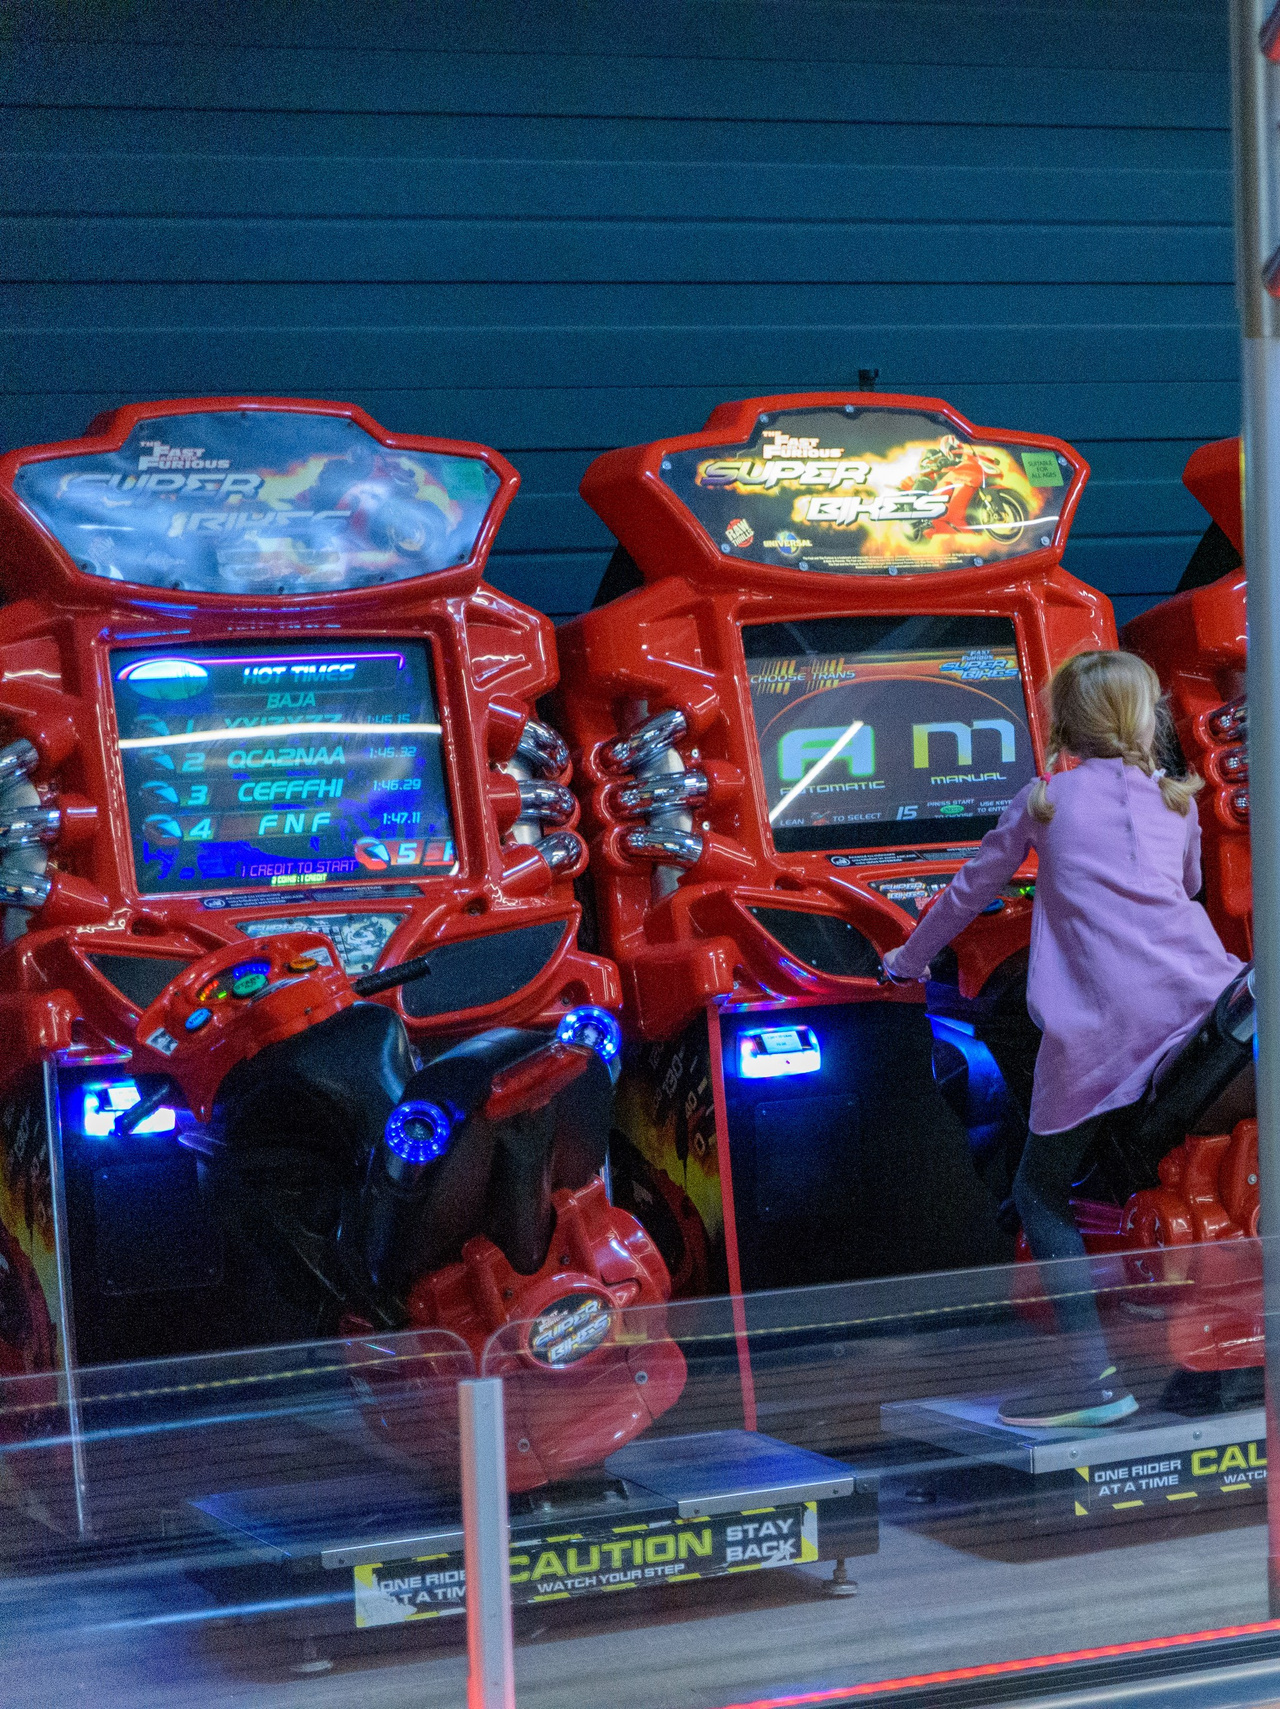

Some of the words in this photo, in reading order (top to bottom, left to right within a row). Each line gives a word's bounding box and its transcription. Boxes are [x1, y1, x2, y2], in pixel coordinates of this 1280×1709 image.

[153, 445, 206, 458] FAST
[763, 444, 842, 459] FURIOUS
[774, 434, 820, 448] FAST
[138, 456, 231, 471] FURIOUS
[701, 461, 872, 490] SUPER
[62, 473, 265, 500] SUPER
[806, 494, 950, 526] BIKES
[725, 518, 751, 541] RAW
[762, 539, 814, 548] UNIVERSAL
[243, 666, 284, 685] HOT
[289, 663, 356, 684] TIMES
[750, 671, 806, 684] CHOOSE
[812, 669, 856, 681] TRANS
[939, 660, 1008, 672] SUPER
[961, 668, 1019, 680] BIKES
[266, 691, 317, 710] BAJA
[181, 751, 206, 773] 2
[931, 772, 1007, 785] MANUAL
[187, 785, 209, 806] 3
[780, 817, 805, 827] LEAN
[847, 812, 883, 822] SELECT
[896, 805, 919, 821] 15
[188, 818, 212, 840] 4
[258, 815, 279, 836] F
[283, 813, 305, 834] N
[310, 811, 332, 833] F
[396, 842, 418, 864] 5
[250, 862, 293, 877] CREDIT
[298, 861, 313, 874] TO
[316, 859, 356, 873] START
[1094, 1467, 1129, 1483] ONE
[1132, 1459, 1181, 1477] RIDER
[1098, 1483, 1121, 1496] AT
[1124, 1482, 1136, 1493] A
[1139, 1474, 1179, 1489] TIME
[726, 1518, 794, 1542] STAY
[509, 1528, 713, 1584] CAUTION
[726, 1538, 797, 1563] BACK
[380, 1576, 422, 1593] ONE
[425, 1570, 467, 1586] RIDE
[537, 1577, 597, 1594] WATCH
[600, 1570, 642, 1584] YOUR
[644, 1563, 685, 1577] STEP
[416, 1591, 431, 1603] A
[434, 1586, 467, 1601] TIM
